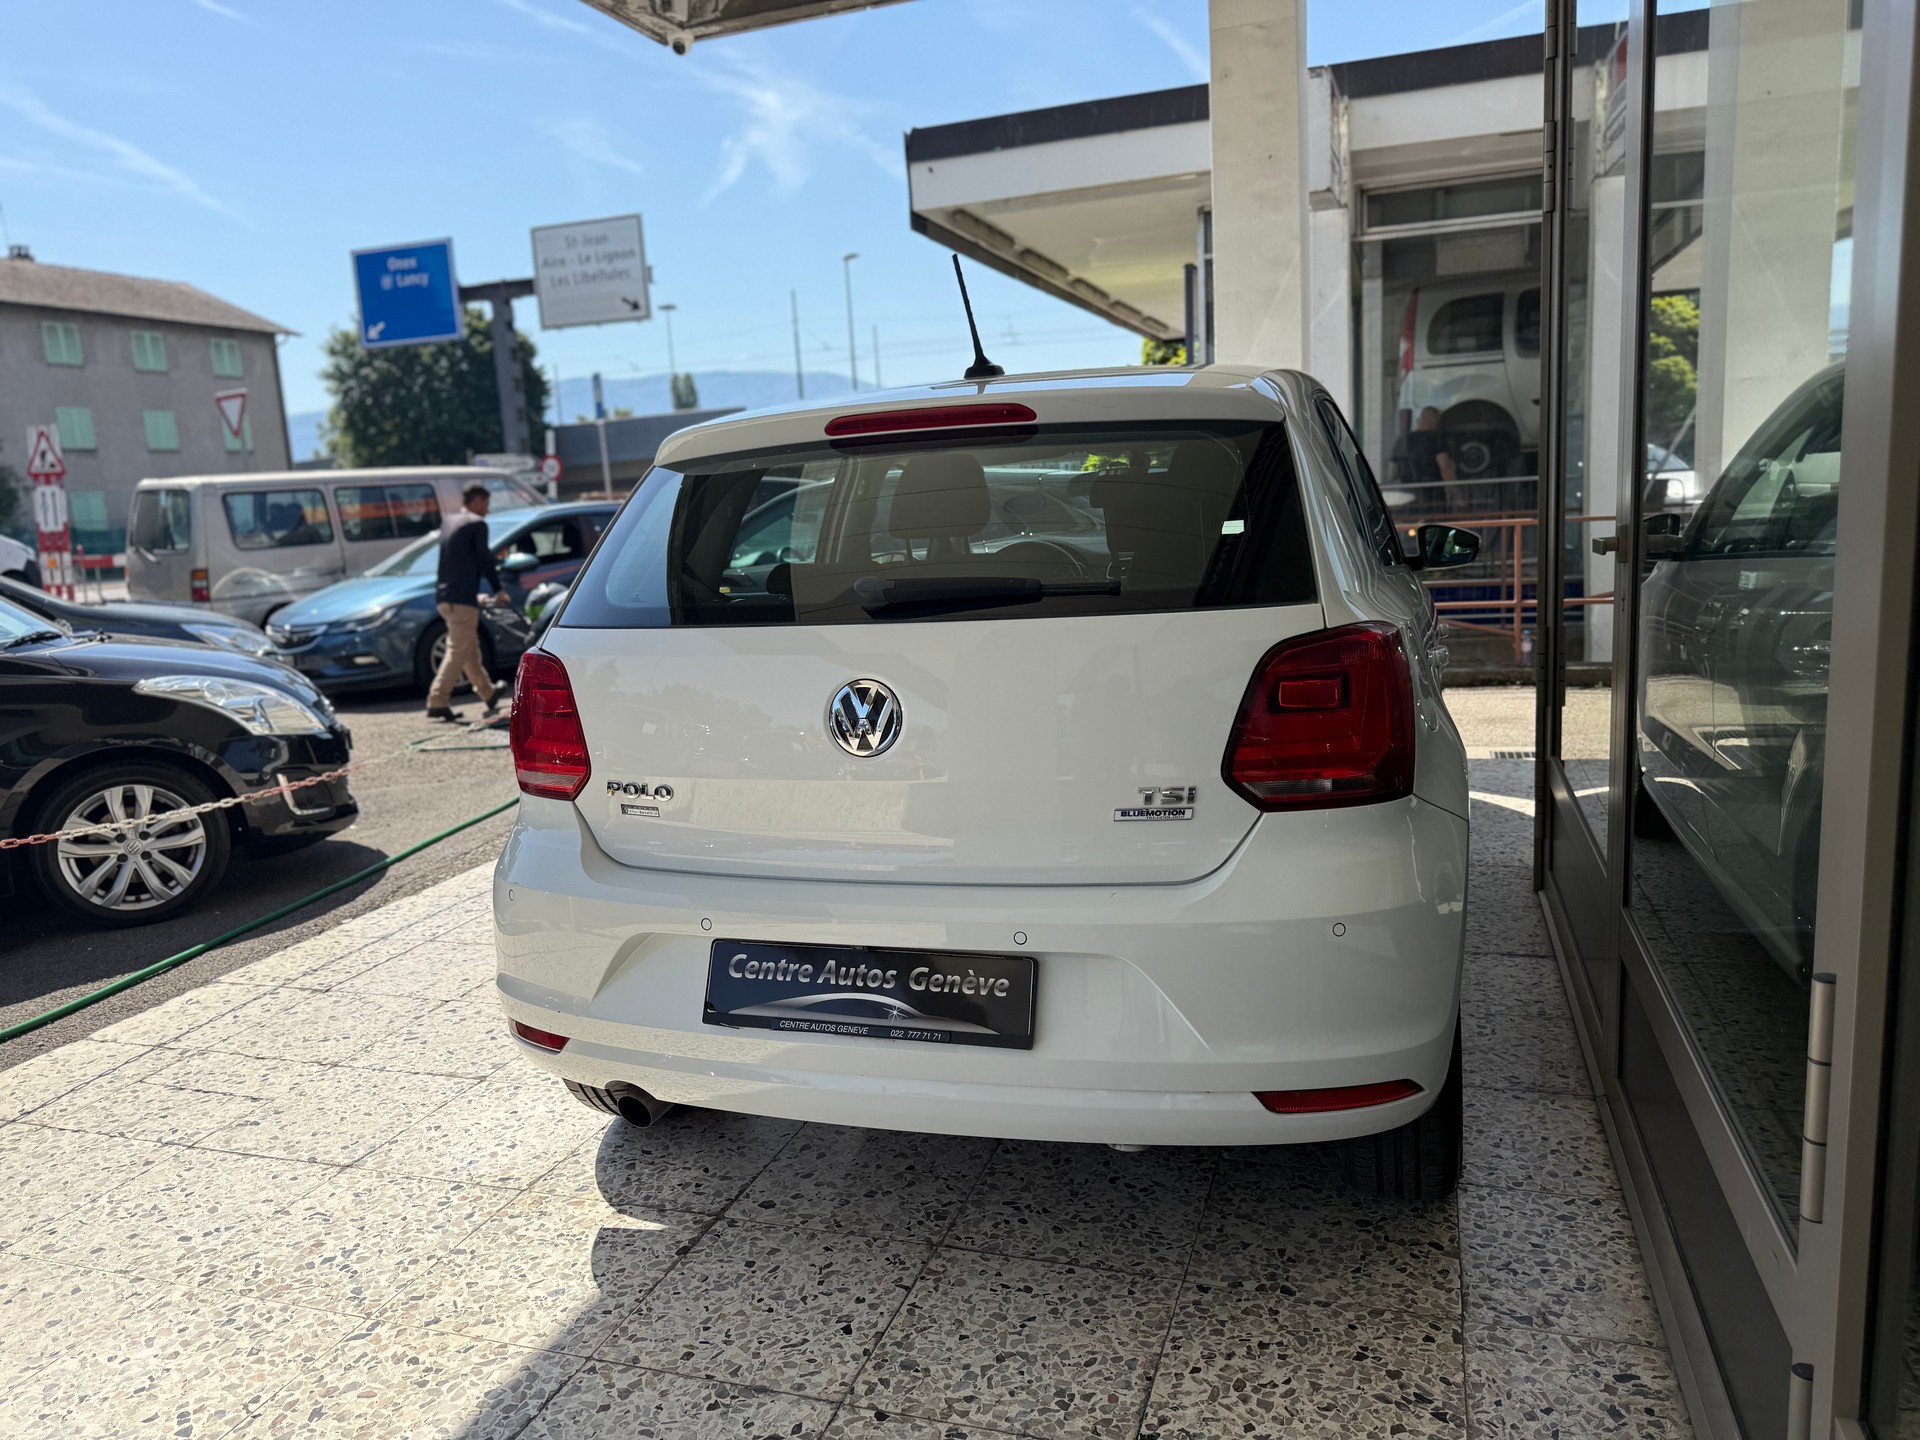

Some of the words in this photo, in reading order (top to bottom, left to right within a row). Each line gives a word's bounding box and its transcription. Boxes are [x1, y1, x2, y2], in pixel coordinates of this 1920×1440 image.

[563, 233, 577, 249] St
[581, 233, 609, 248] Jean
[577, 252, 591, 266] Le
[594, 248, 636, 266] Lignon
[549, 275, 570, 289] Les
[606, 780, 675, 802] POLO
[1120, 809, 1186, 817] BLUEMOTION
[728, 953, 813, 983] Centre
[816, 959, 896, 989] Autos
[908, 967, 1010, 997] Genève
[779, 1020, 810, 1031] CENTRE
[810, 1023, 836, 1032] AUTOS
[837, 1025, 869, 1035] GENEVE
[890, 1029, 903, 1038] 022
[907, 1031, 920, 1039] 777
[922, 1032, 931, 1040] 71
[933, 1032, 942, 1041] 71
